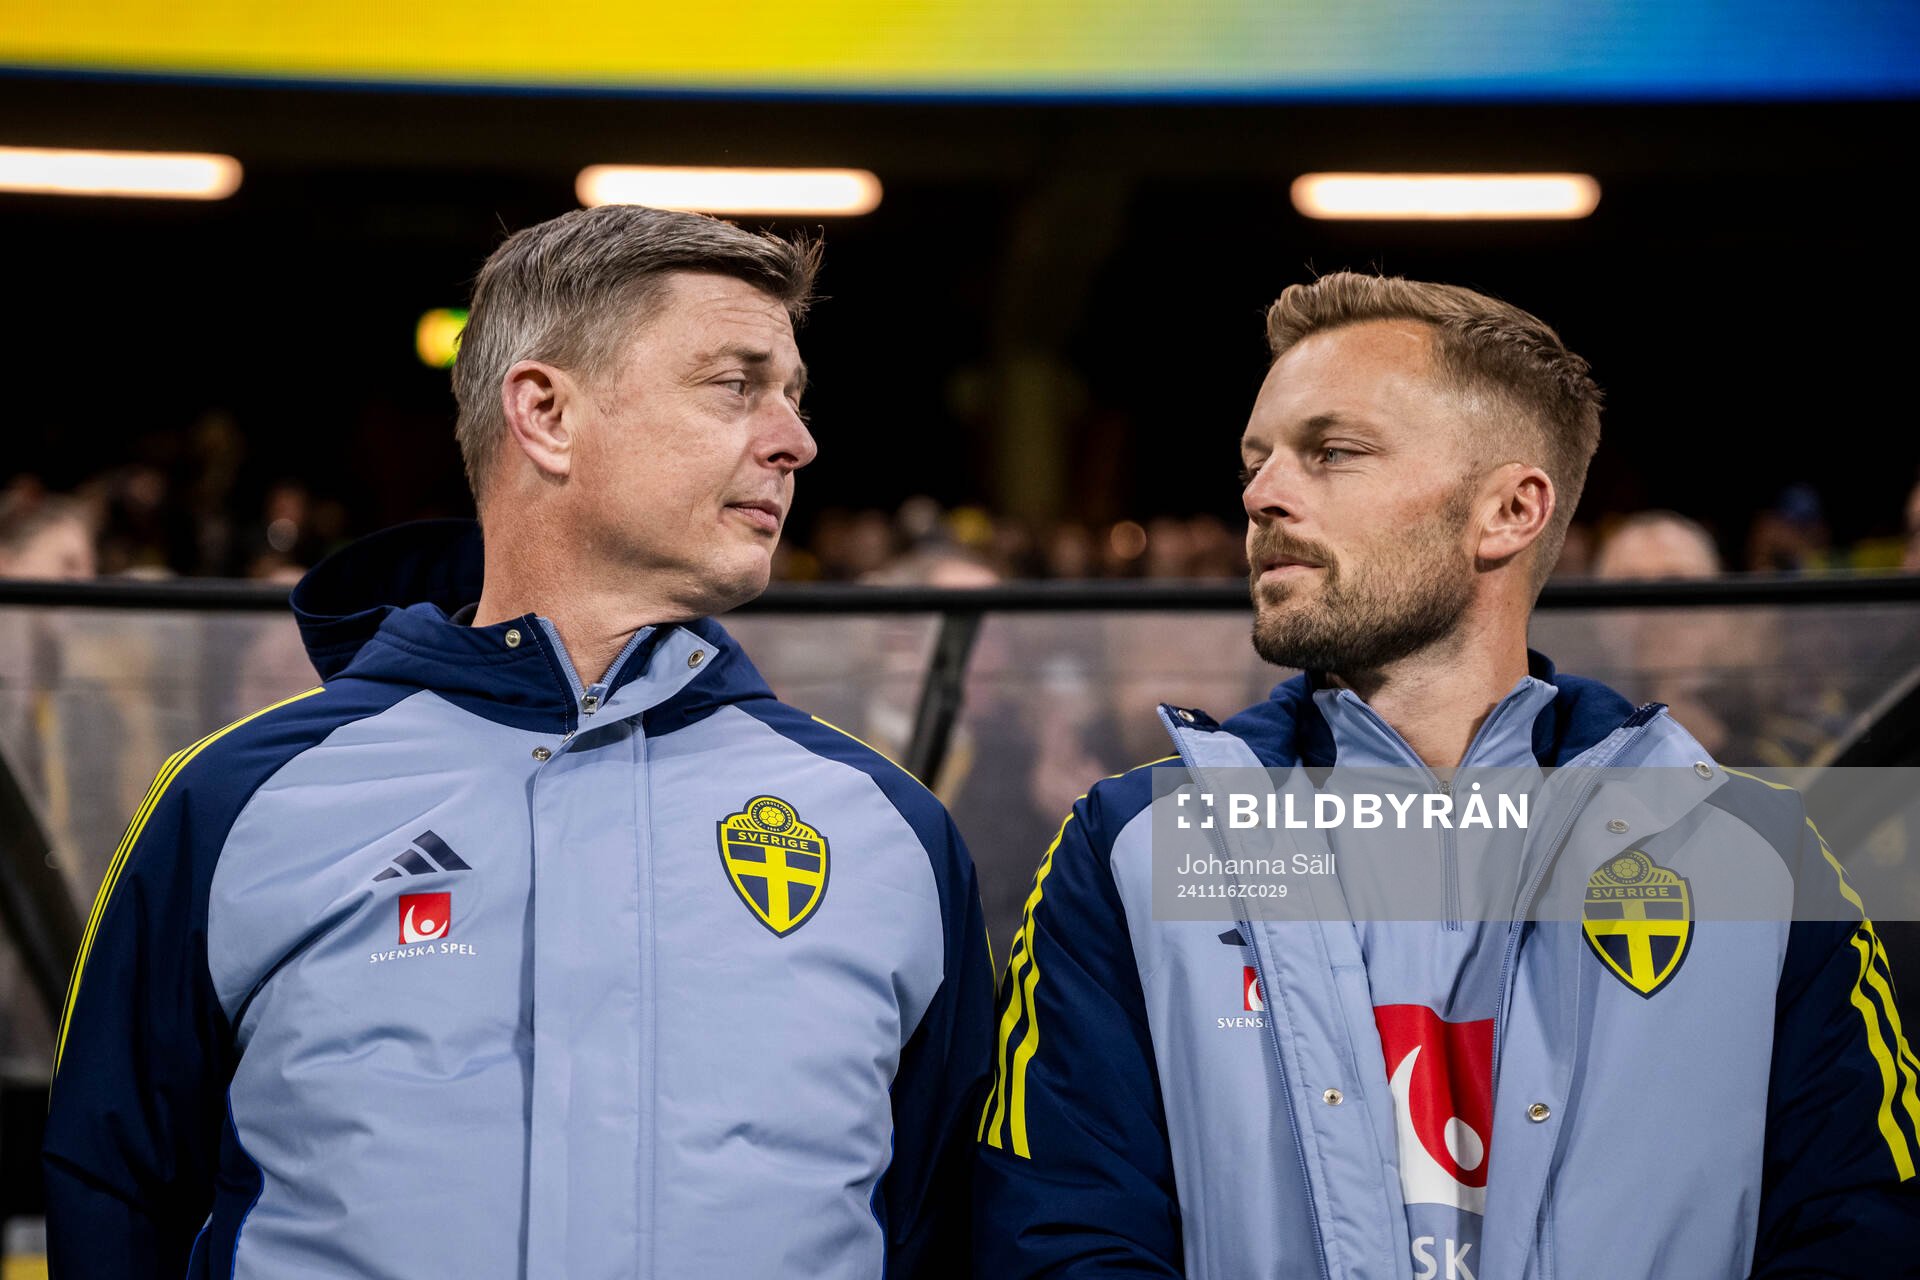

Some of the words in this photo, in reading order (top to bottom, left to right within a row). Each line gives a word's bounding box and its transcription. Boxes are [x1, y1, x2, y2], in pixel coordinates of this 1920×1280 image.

[738, 831, 809, 850] SVERIGE
[1592, 887, 1670, 899] SVERIGE
[369, 945, 436, 964] SVENSKA
[440, 942, 477, 956] SPEL
